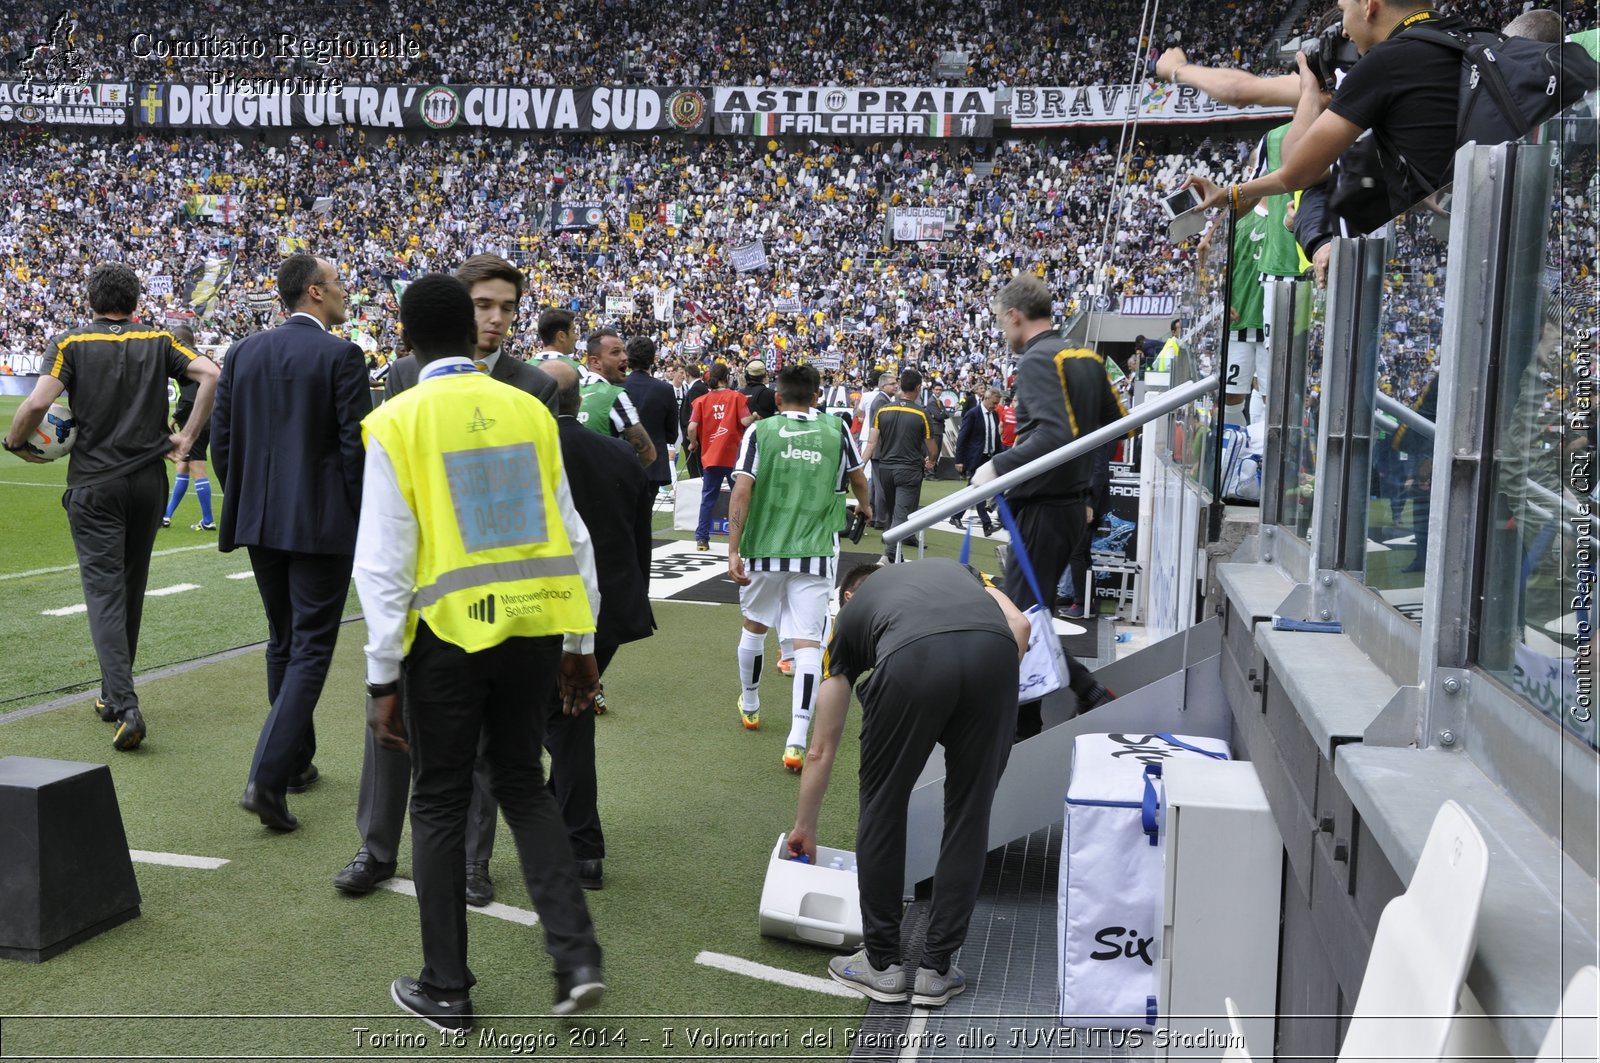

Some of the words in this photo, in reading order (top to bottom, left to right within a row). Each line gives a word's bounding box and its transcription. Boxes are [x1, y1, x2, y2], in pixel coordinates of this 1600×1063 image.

[1403, 12, 1430, 26] Nikon
[168, 84, 293, 126] DRUGHI
[464, 87, 579, 129] CURVA
[591, 88, 661, 130] SUD
[722, 90, 819, 112] ASTI
[857, 91, 986, 113] PRAIA
[1014, 86, 1140, 118] BRAVI
[779, 115, 924, 134] FALCHERA
[895, 207, 946, 218] GRUGLIASCO
[1123, 296, 1173, 314] ANDRIA
[712, 404, 724, 412] TV
[780, 444, 822, 464] Jeep
[451, 456, 533, 497] STEWARD
[474, 500, 528, 536] 0465
[505, 604, 542, 617] Solutions
